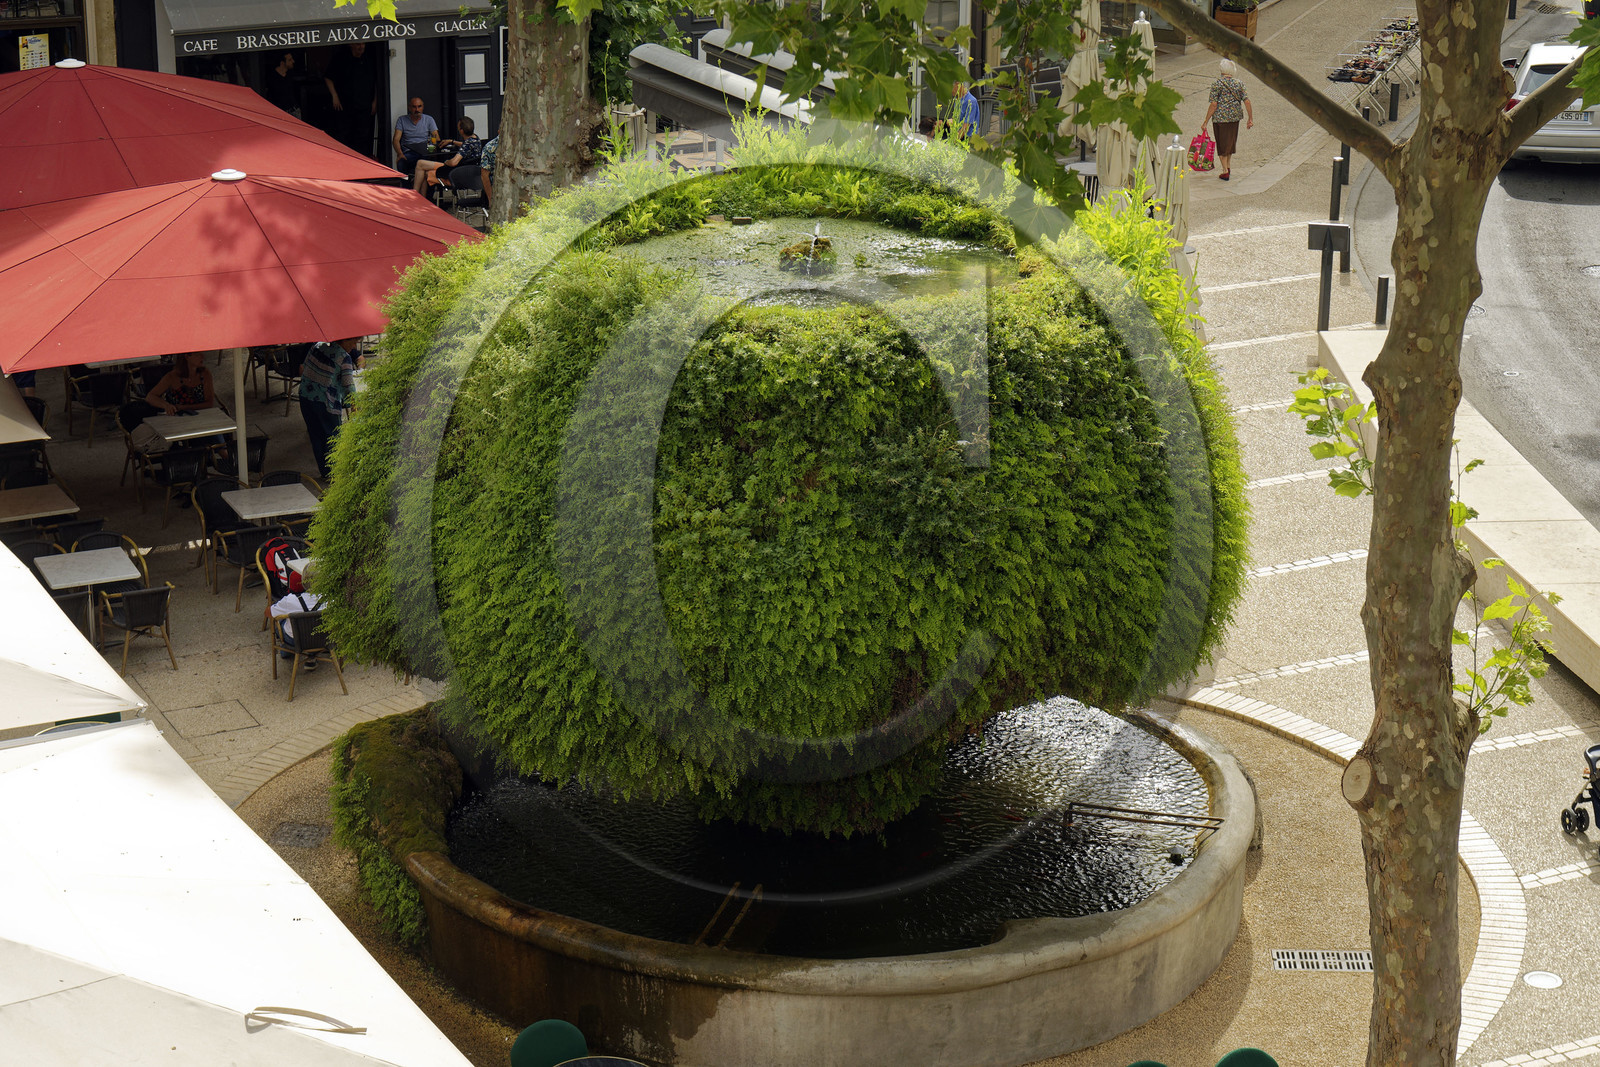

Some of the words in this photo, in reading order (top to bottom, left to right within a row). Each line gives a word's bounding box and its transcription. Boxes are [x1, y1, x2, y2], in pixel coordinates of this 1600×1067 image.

[183, 39, 218, 52] CAFE
[236, 29, 321, 49] BRASSERIE
[327, 26, 359, 42] AUX
[361, 23, 371, 39] 2
[373, 23, 417, 38] GROS
